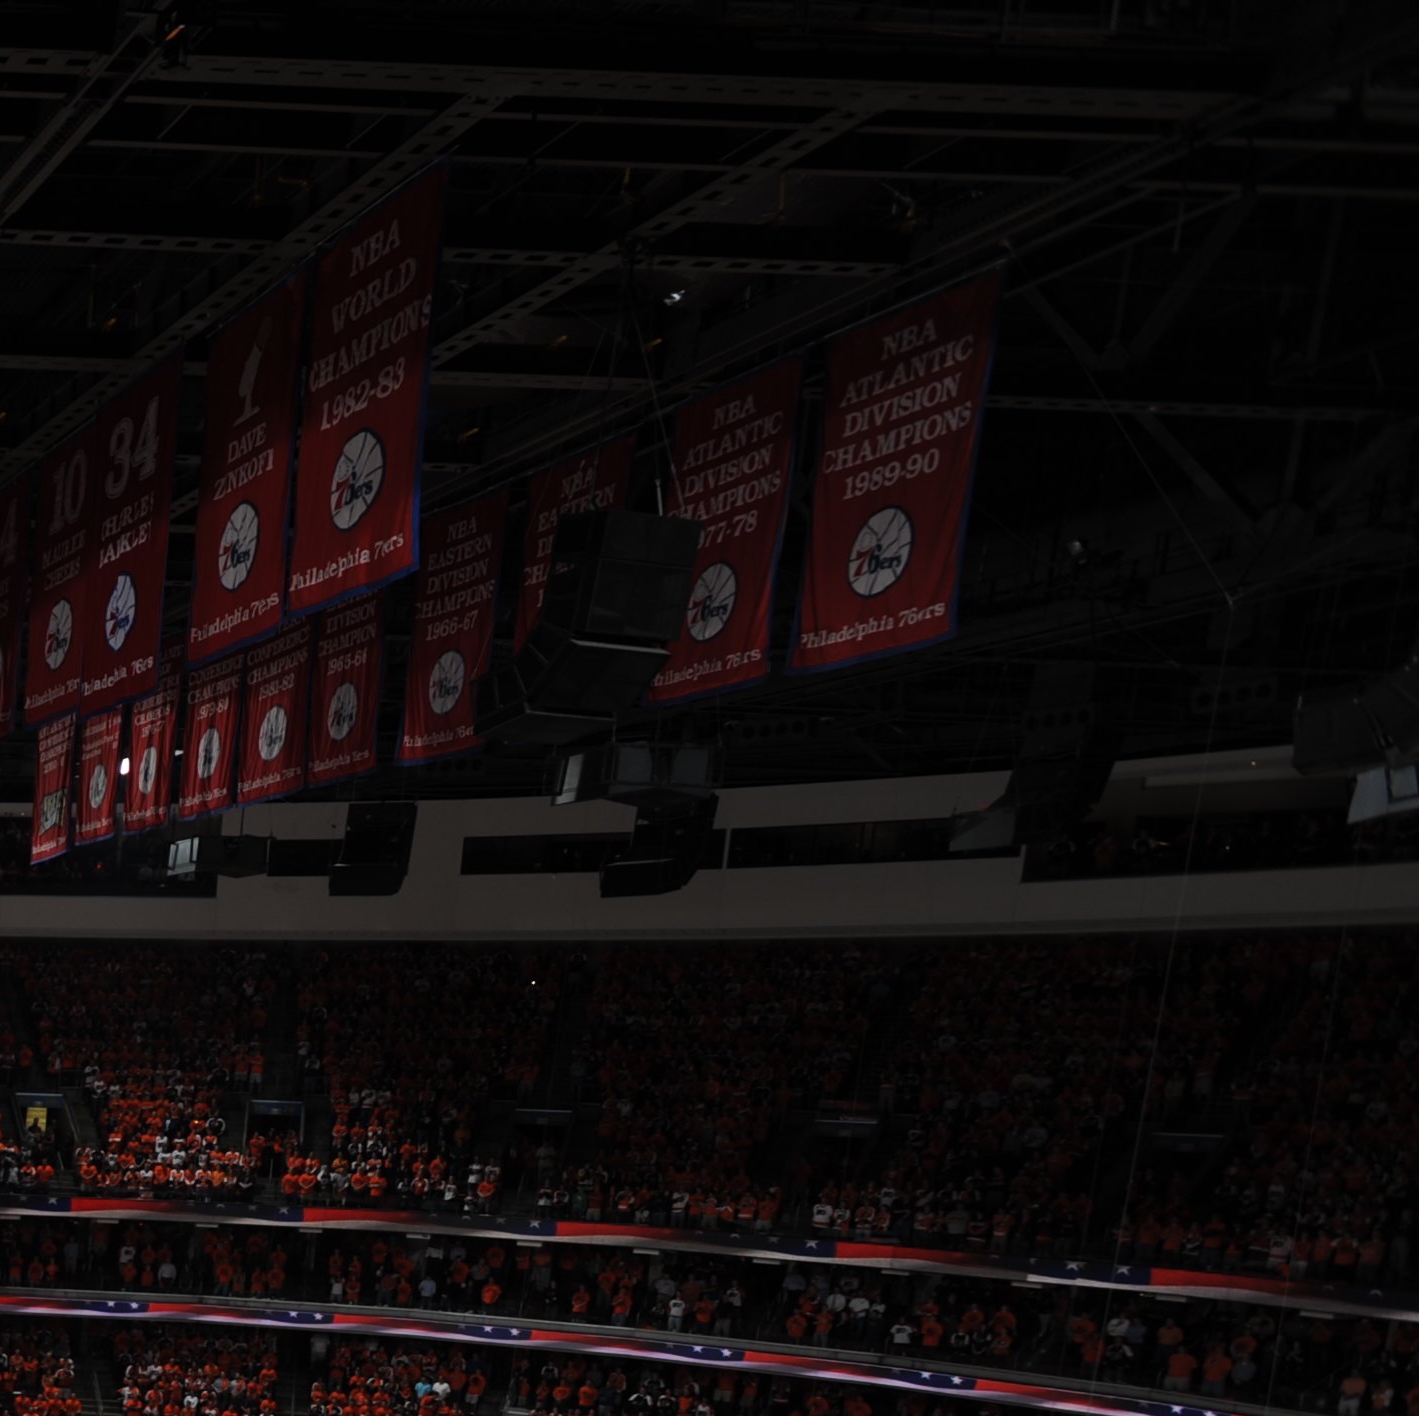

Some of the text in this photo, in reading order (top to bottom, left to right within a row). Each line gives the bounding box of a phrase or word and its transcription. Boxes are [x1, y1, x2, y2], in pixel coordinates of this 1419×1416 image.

[349, 219, 401, 279] NBA
[331, 257, 418, 334] WORLD
[309, 293, 433, 394] CHAMPIONS
[880, 318, 938, 361] NBA
[320, 356, 407, 431] 1982-83
[840, 334, 975, 408] ATLANTIC
[712, 393, 757, 430] NBA
[842, 372, 962, 438] DIVISION
[105, 396, 161, 499] 34
[227, 422, 267, 464] DAVE
[683, 411, 784, 471] ATLANTIC
[823, 401, 973, 474] CHAMPIONS
[48, 449, 88, 536] 10
[683, 444, 774, 498] DIVISION
[842, 448, 940, 500] 1989-90
[427, 532, 493, 572] EASTERN
[447, 516, 477, 543] NBA
[289, 549, 370, 592] Philadelphia
[427, 558, 490, 595] DIVISION
[852, 543, 902, 579] 76ers
[415, 578, 496, 620] CHAMPIONS
[425, 609, 479, 642] 1966-67
[800, 602, 946, 650] Philadelphia 76ers
[247, 647, 309, 686] CHAMPIONS
[259, 672, 296, 701] 1981-82
